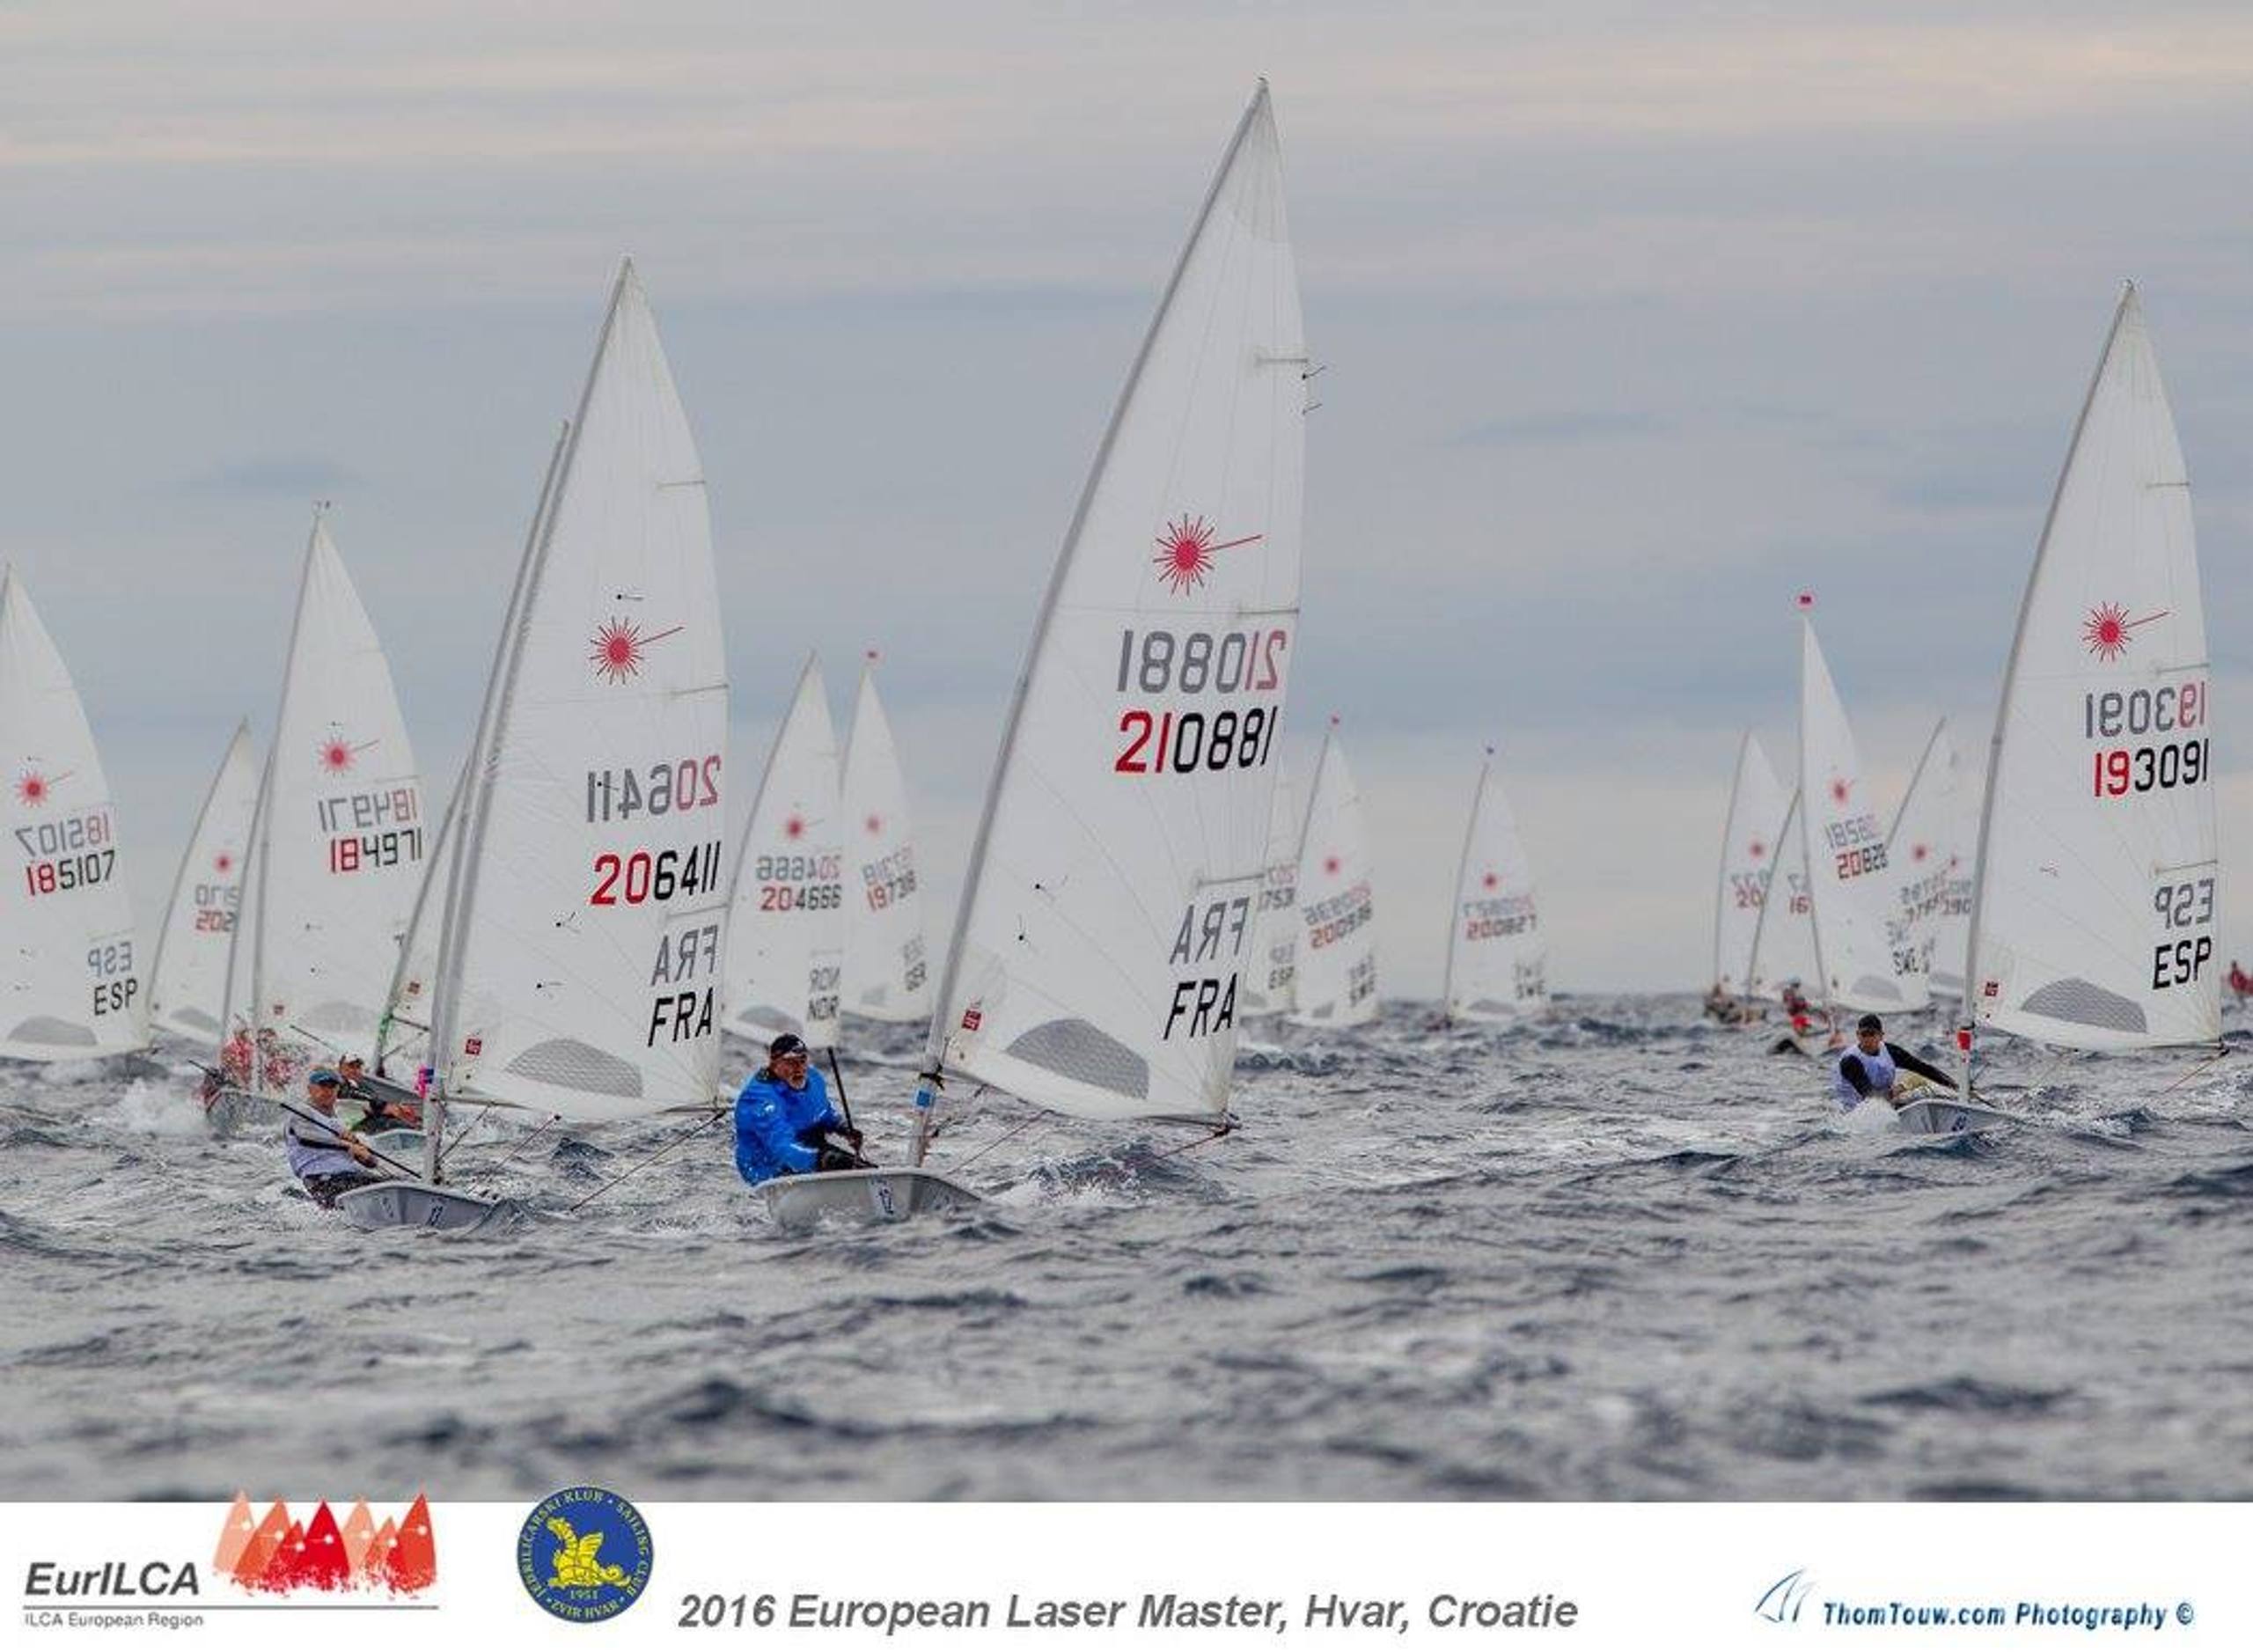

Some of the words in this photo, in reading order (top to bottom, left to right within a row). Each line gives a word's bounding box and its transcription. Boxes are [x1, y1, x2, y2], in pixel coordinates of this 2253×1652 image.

[1115, 706, 1278, 774] 210881
[2094, 738, 2209, 797] 193091
[26, 849, 115, 897] 185107
[330, 827, 422, 874] 184971
[591, 841, 721, 906] 206411
[760, 885, 842, 912] 204666
[2152, 936, 2213, 991] ESP
[93, 978, 138, 1016] ESP
[648, 987, 714, 1047] FRA
[1163, 973, 1238, 1040] FRA
